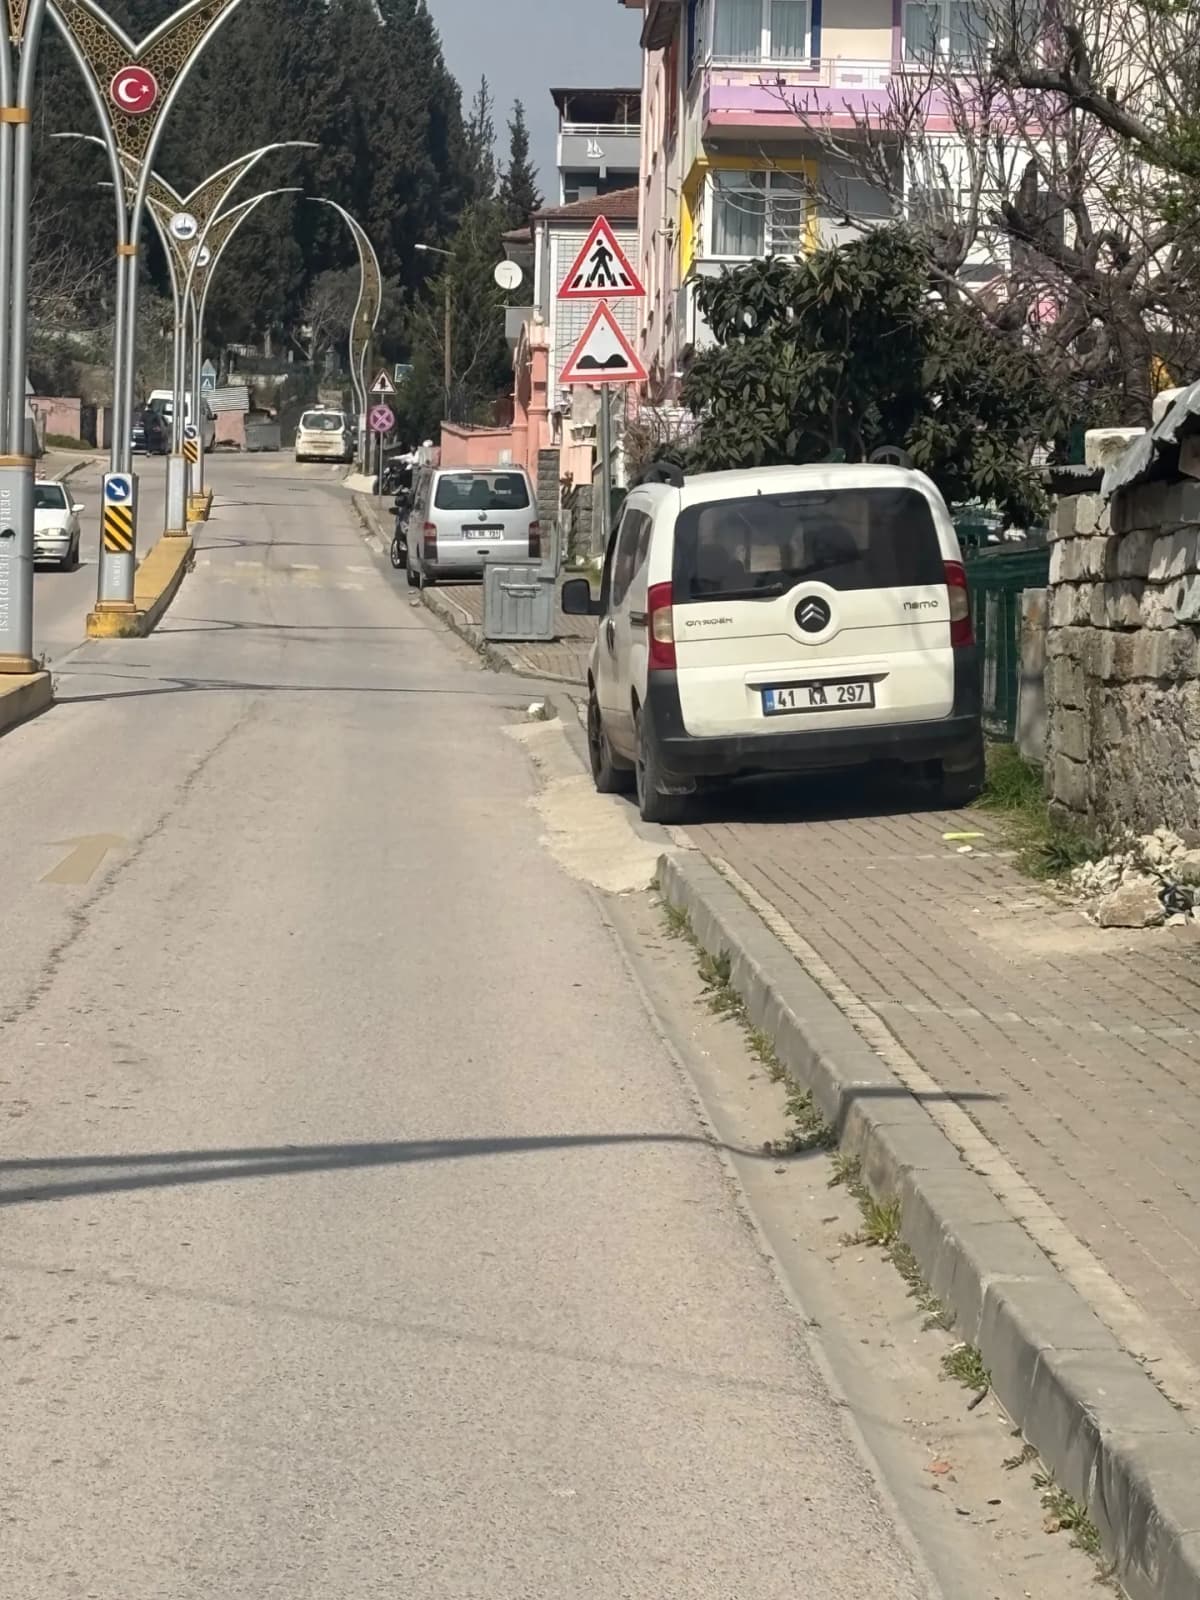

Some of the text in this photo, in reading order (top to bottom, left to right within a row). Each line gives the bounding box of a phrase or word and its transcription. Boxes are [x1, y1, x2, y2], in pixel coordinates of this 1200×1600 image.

[778, 684, 864, 707] 41 KA 297
